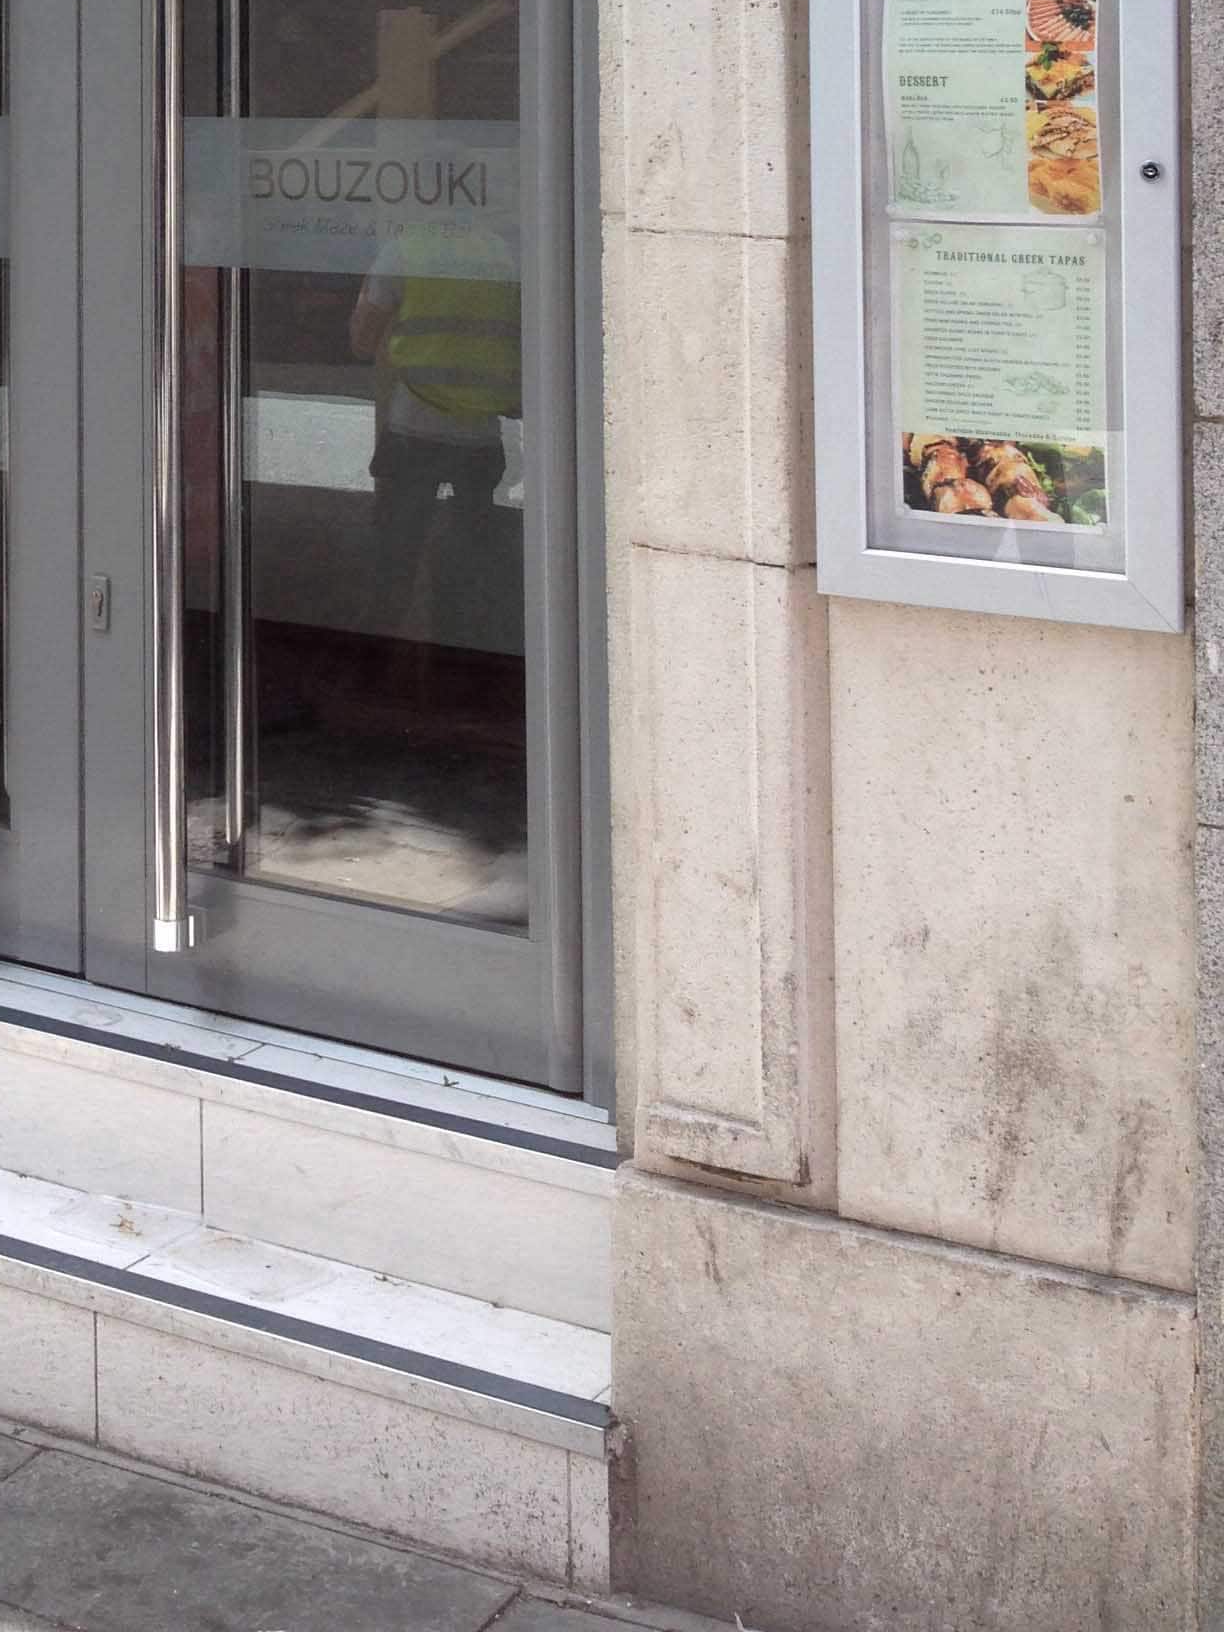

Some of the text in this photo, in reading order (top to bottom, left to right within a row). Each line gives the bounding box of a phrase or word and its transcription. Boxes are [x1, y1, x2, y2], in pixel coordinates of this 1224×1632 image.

[899, 76, 948, 87] DESSERT
[249, 158, 487, 207] BOUZOUKI
[936, 250, 1085, 266] TRADITIONAL GREEK TAPAS
